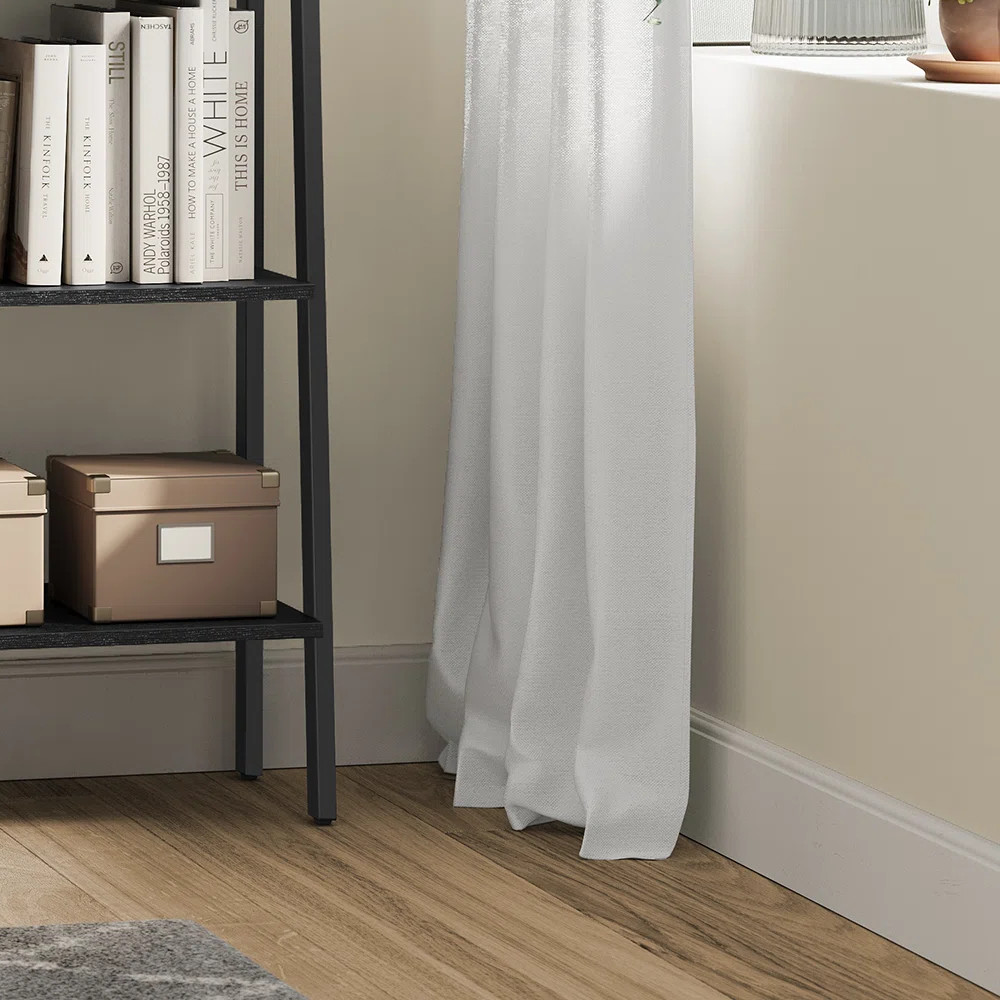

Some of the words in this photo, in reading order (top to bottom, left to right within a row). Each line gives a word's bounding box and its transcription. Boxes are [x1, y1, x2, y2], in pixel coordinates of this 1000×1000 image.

[108, 42, 125, 84] STILL
[188, 67, 196, 95] HOME
[203, 51, 227, 157] WHITE
[235, 81, 248, 129] HOME
[188, 108, 196, 139] HOUSE
[235, 135, 248, 148] IS
[41, 135, 52, 190] KINFOLK
[83, 135, 92, 190] KINFOLK
[188, 151, 196, 177] MAKE
[235, 153, 248, 191] THIS
[188, 180, 196, 192] TO
[143, 189, 156, 239] WARHOL
[188, 196, 196, 219] HOW
[143, 242, 156, 274] ANDY
[157, 223, 170, 275] Polaroids
